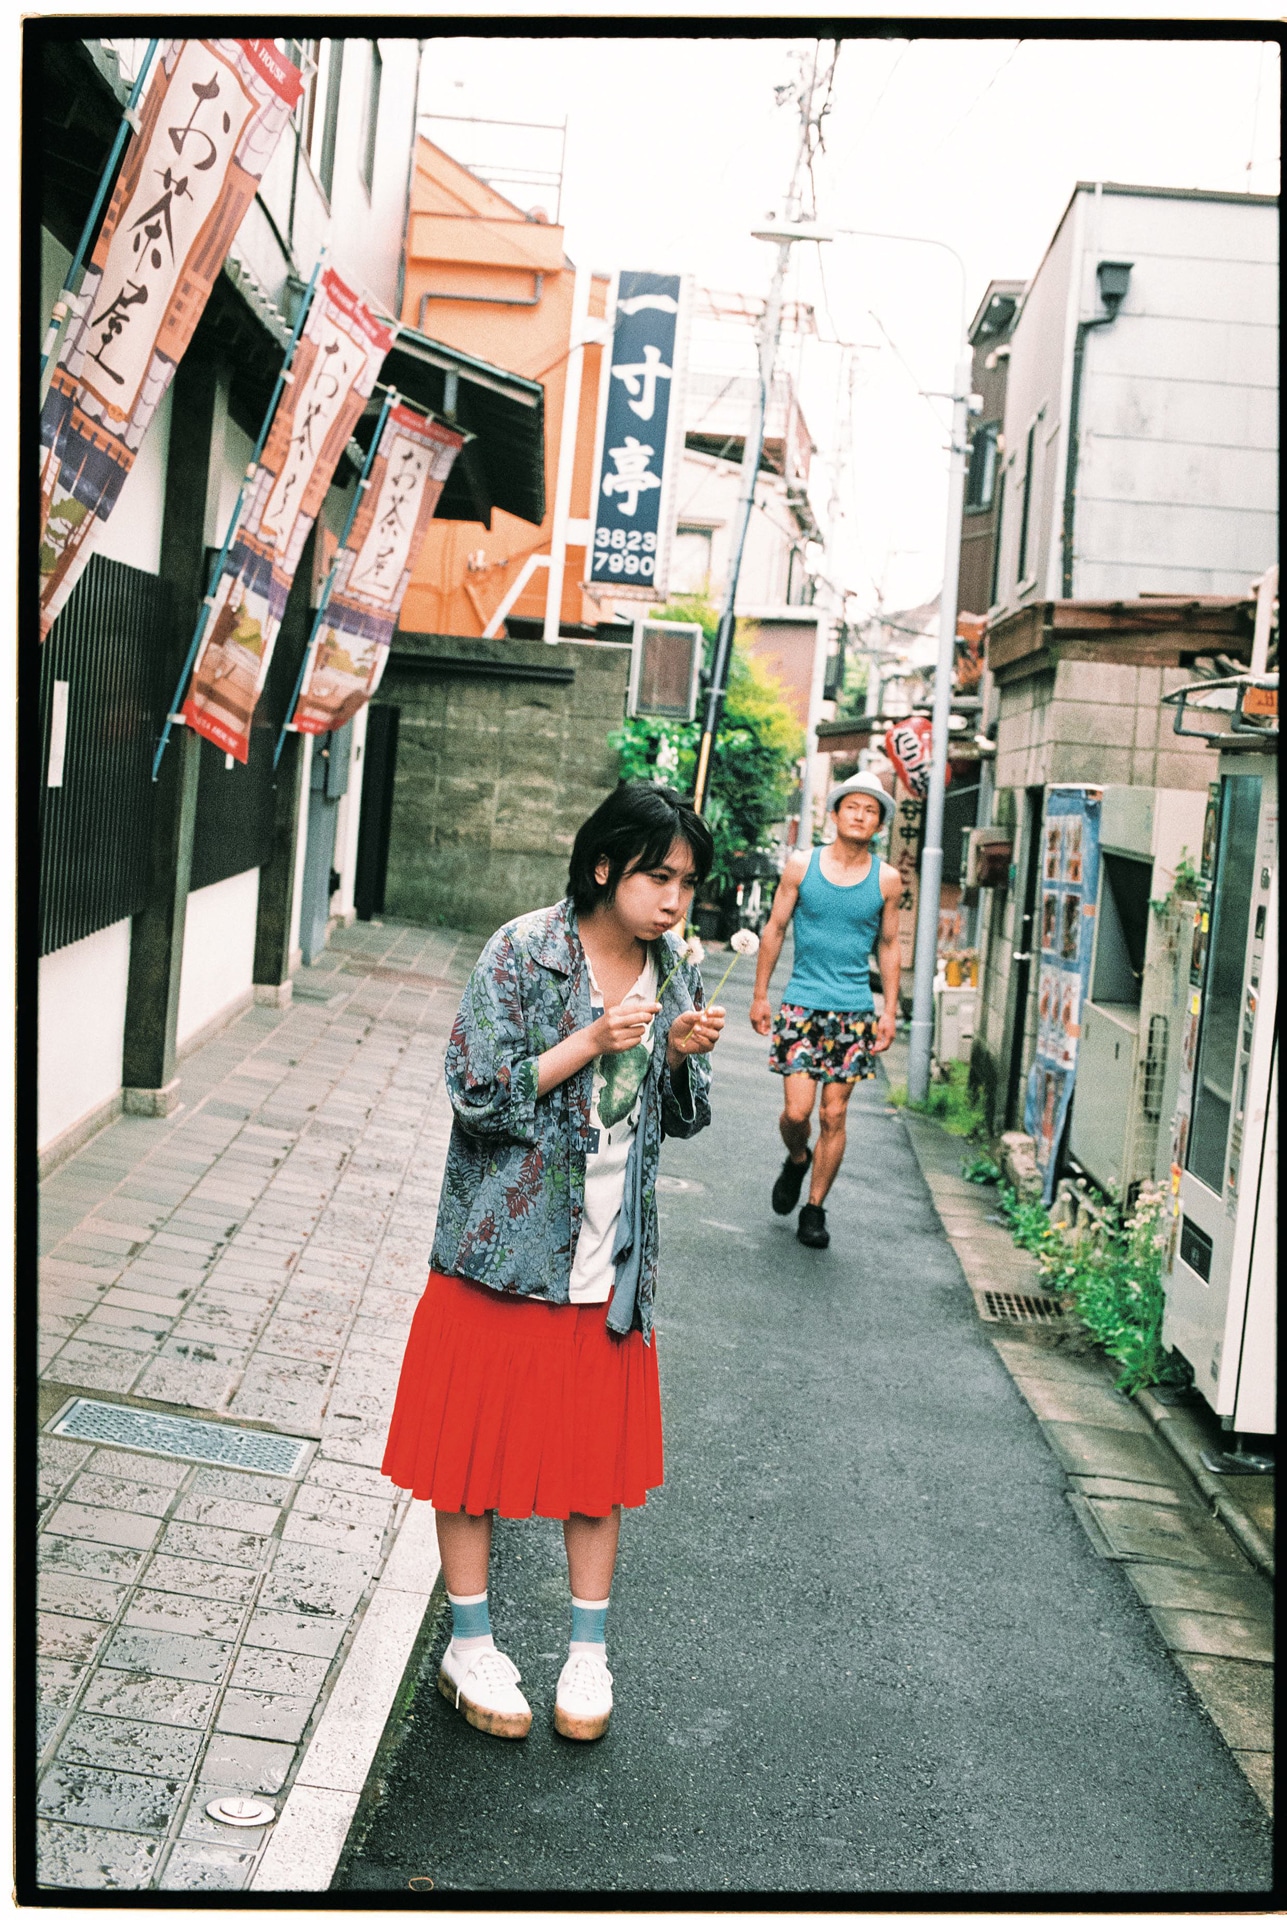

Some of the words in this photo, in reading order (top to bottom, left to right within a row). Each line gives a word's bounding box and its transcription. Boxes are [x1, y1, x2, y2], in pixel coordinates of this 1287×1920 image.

[259, 47, 286, 85] HOUSE
[86, 71, 230, 385] お茶屋
[602, 294, 679, 517] 一寸亭
[354, 450, 422, 591] お茶屋
[593, 551, 656, 577] 7990
[595, 527, 658, 553] 3823
